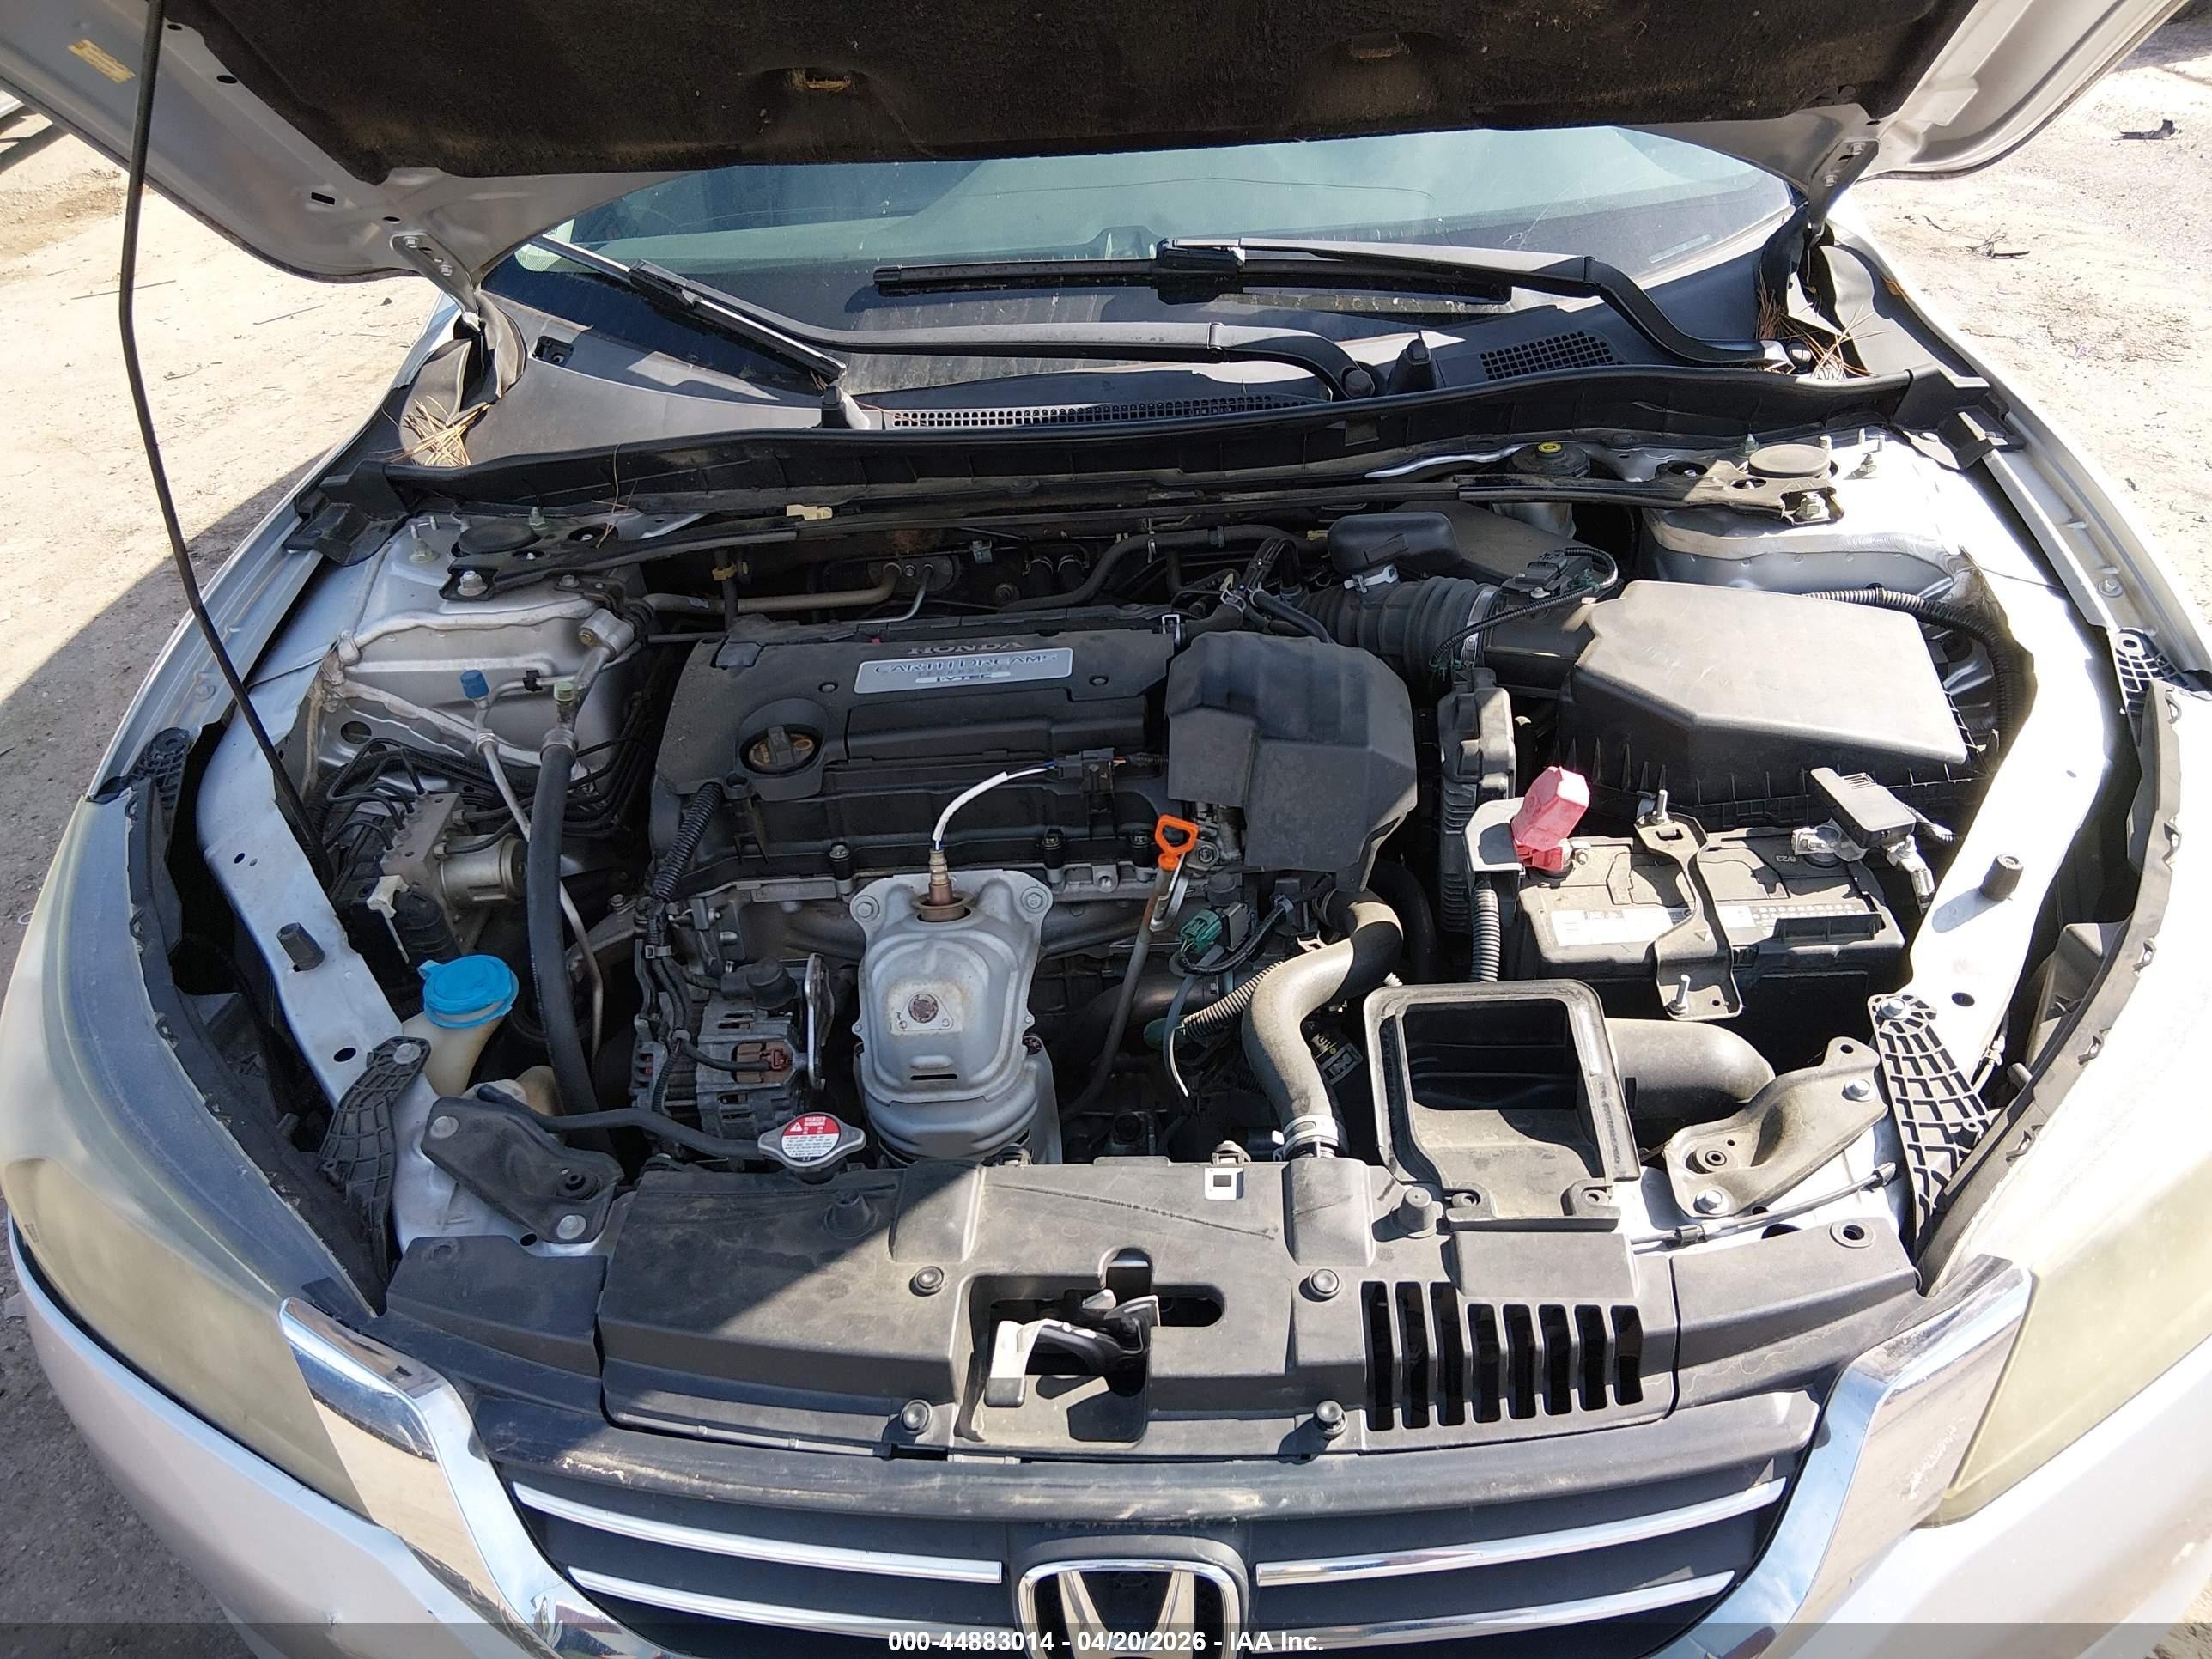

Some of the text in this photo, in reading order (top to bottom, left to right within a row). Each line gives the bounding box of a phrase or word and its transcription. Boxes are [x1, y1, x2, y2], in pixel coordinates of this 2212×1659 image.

[908, 641, 1025, 655] HONDA
[872, 653, 1059, 674] EARTH DREAMS
